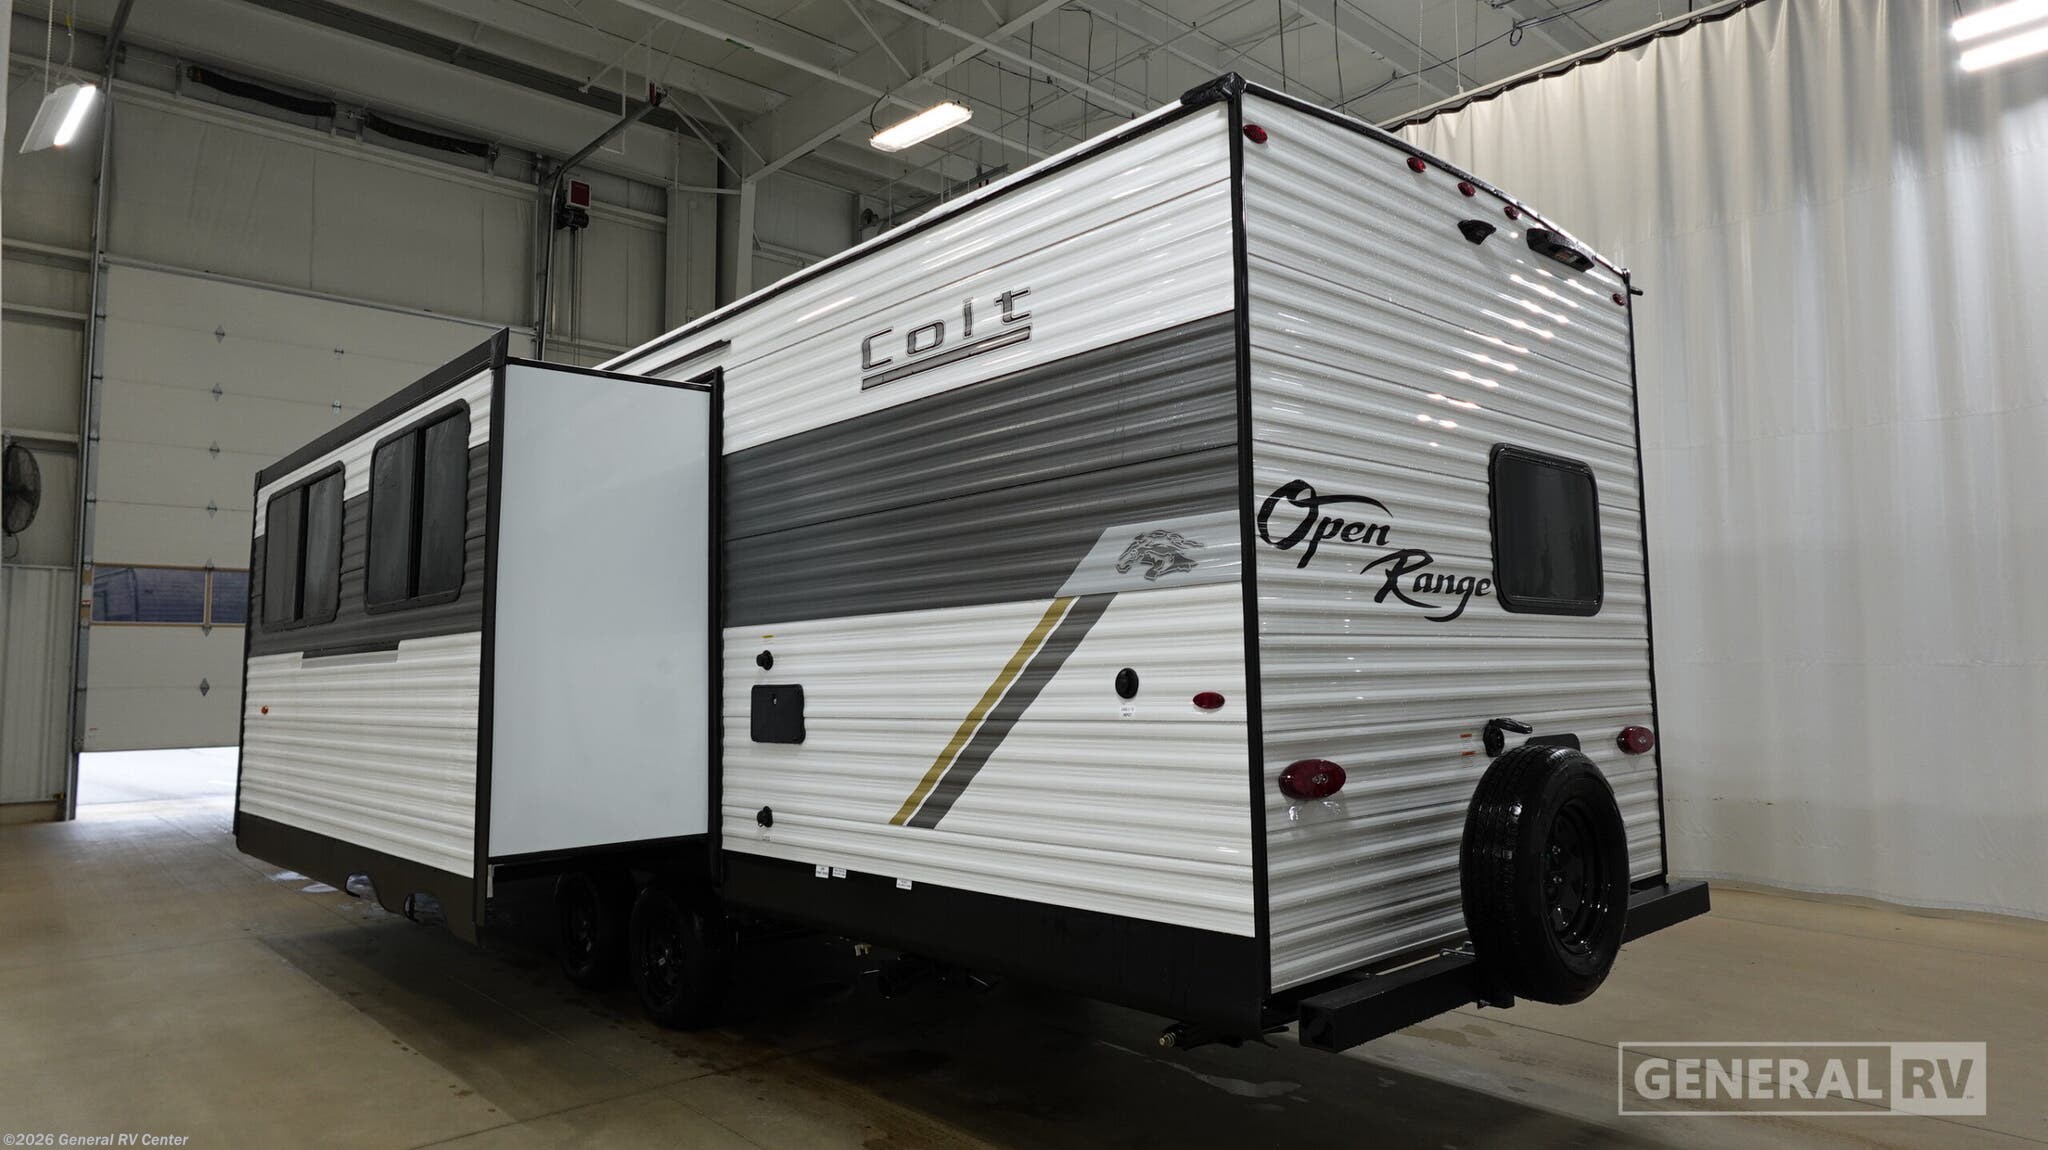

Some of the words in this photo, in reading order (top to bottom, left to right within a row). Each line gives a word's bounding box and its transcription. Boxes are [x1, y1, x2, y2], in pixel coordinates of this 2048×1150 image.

[861, 287, 1032, 372] Colt
[1257, 479, 1394, 569] Open
[1359, 548, 1492, 622] Range
